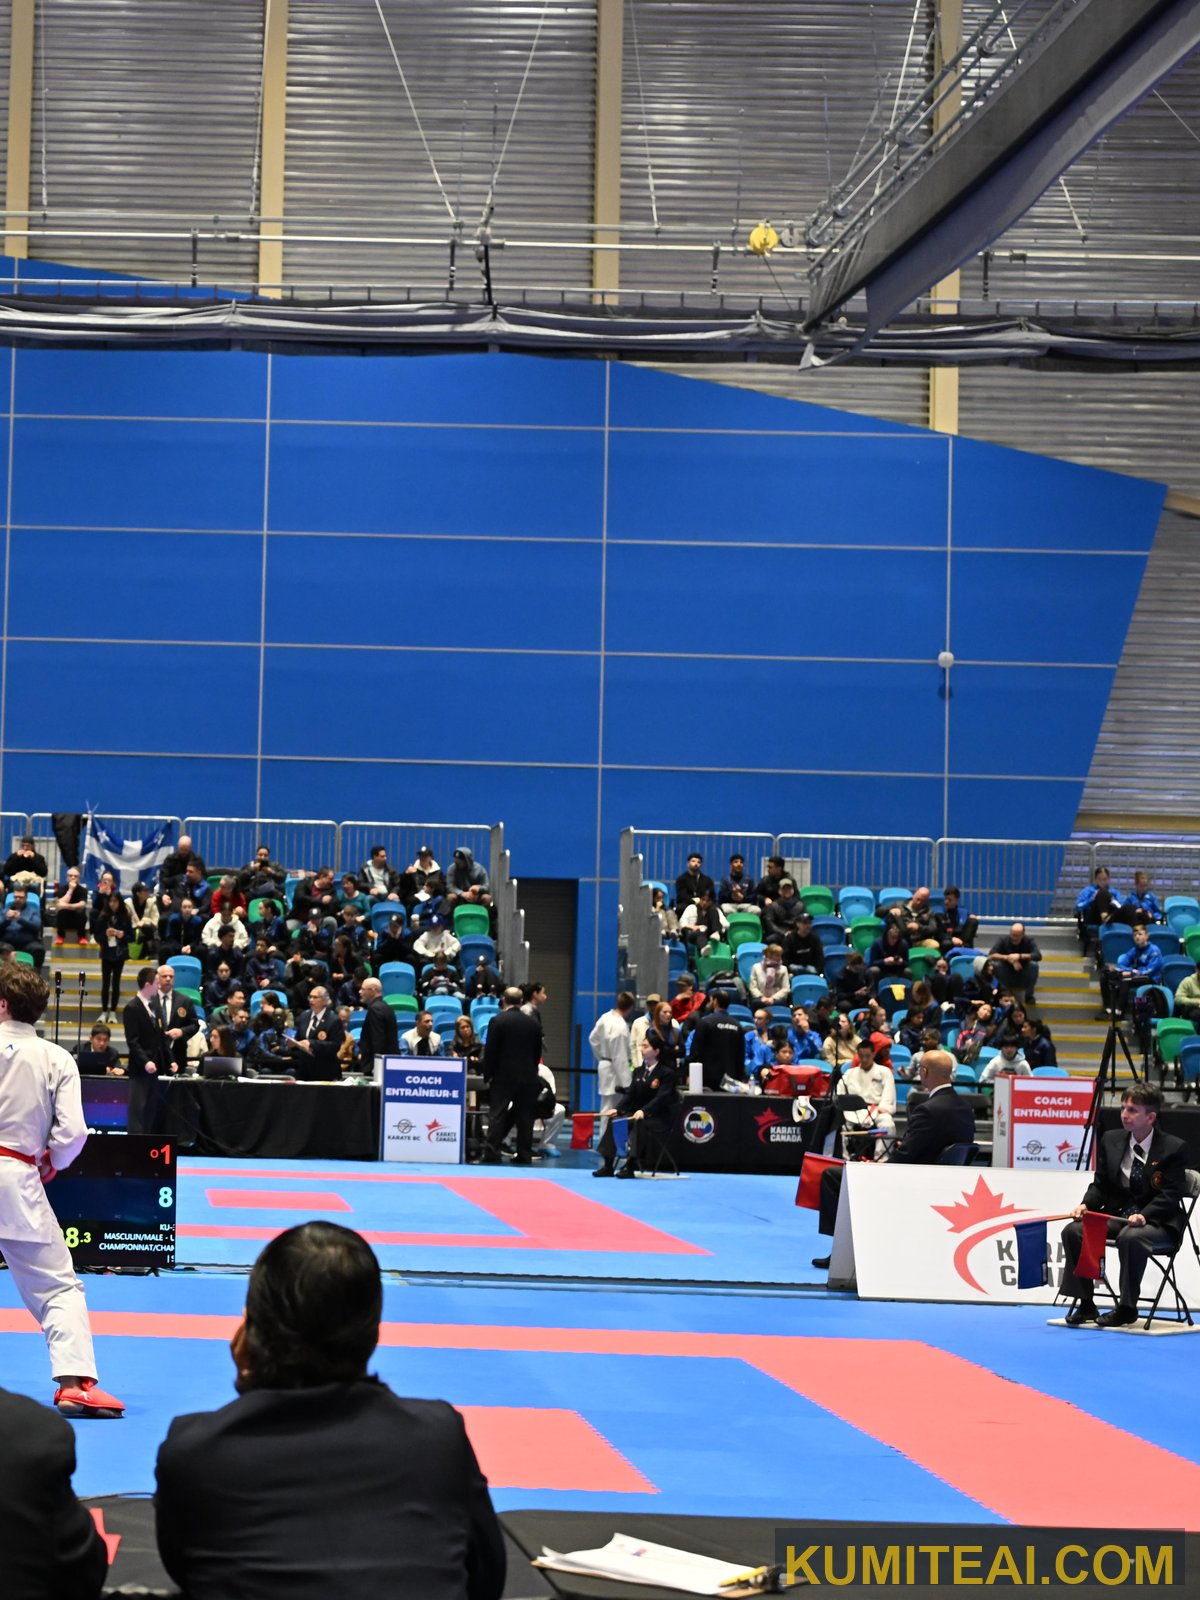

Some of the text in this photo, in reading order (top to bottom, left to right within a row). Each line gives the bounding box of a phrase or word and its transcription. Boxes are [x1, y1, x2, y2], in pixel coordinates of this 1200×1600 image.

[405, 1075, 442, 1085] COACH
[1034, 1096, 1072, 1106] COACH
[770, 1134, 802, 1142] CANADA
[158, 1186, 174, 1208] 8
[104, 1232, 164, 1242] MASCULIN/MALE
